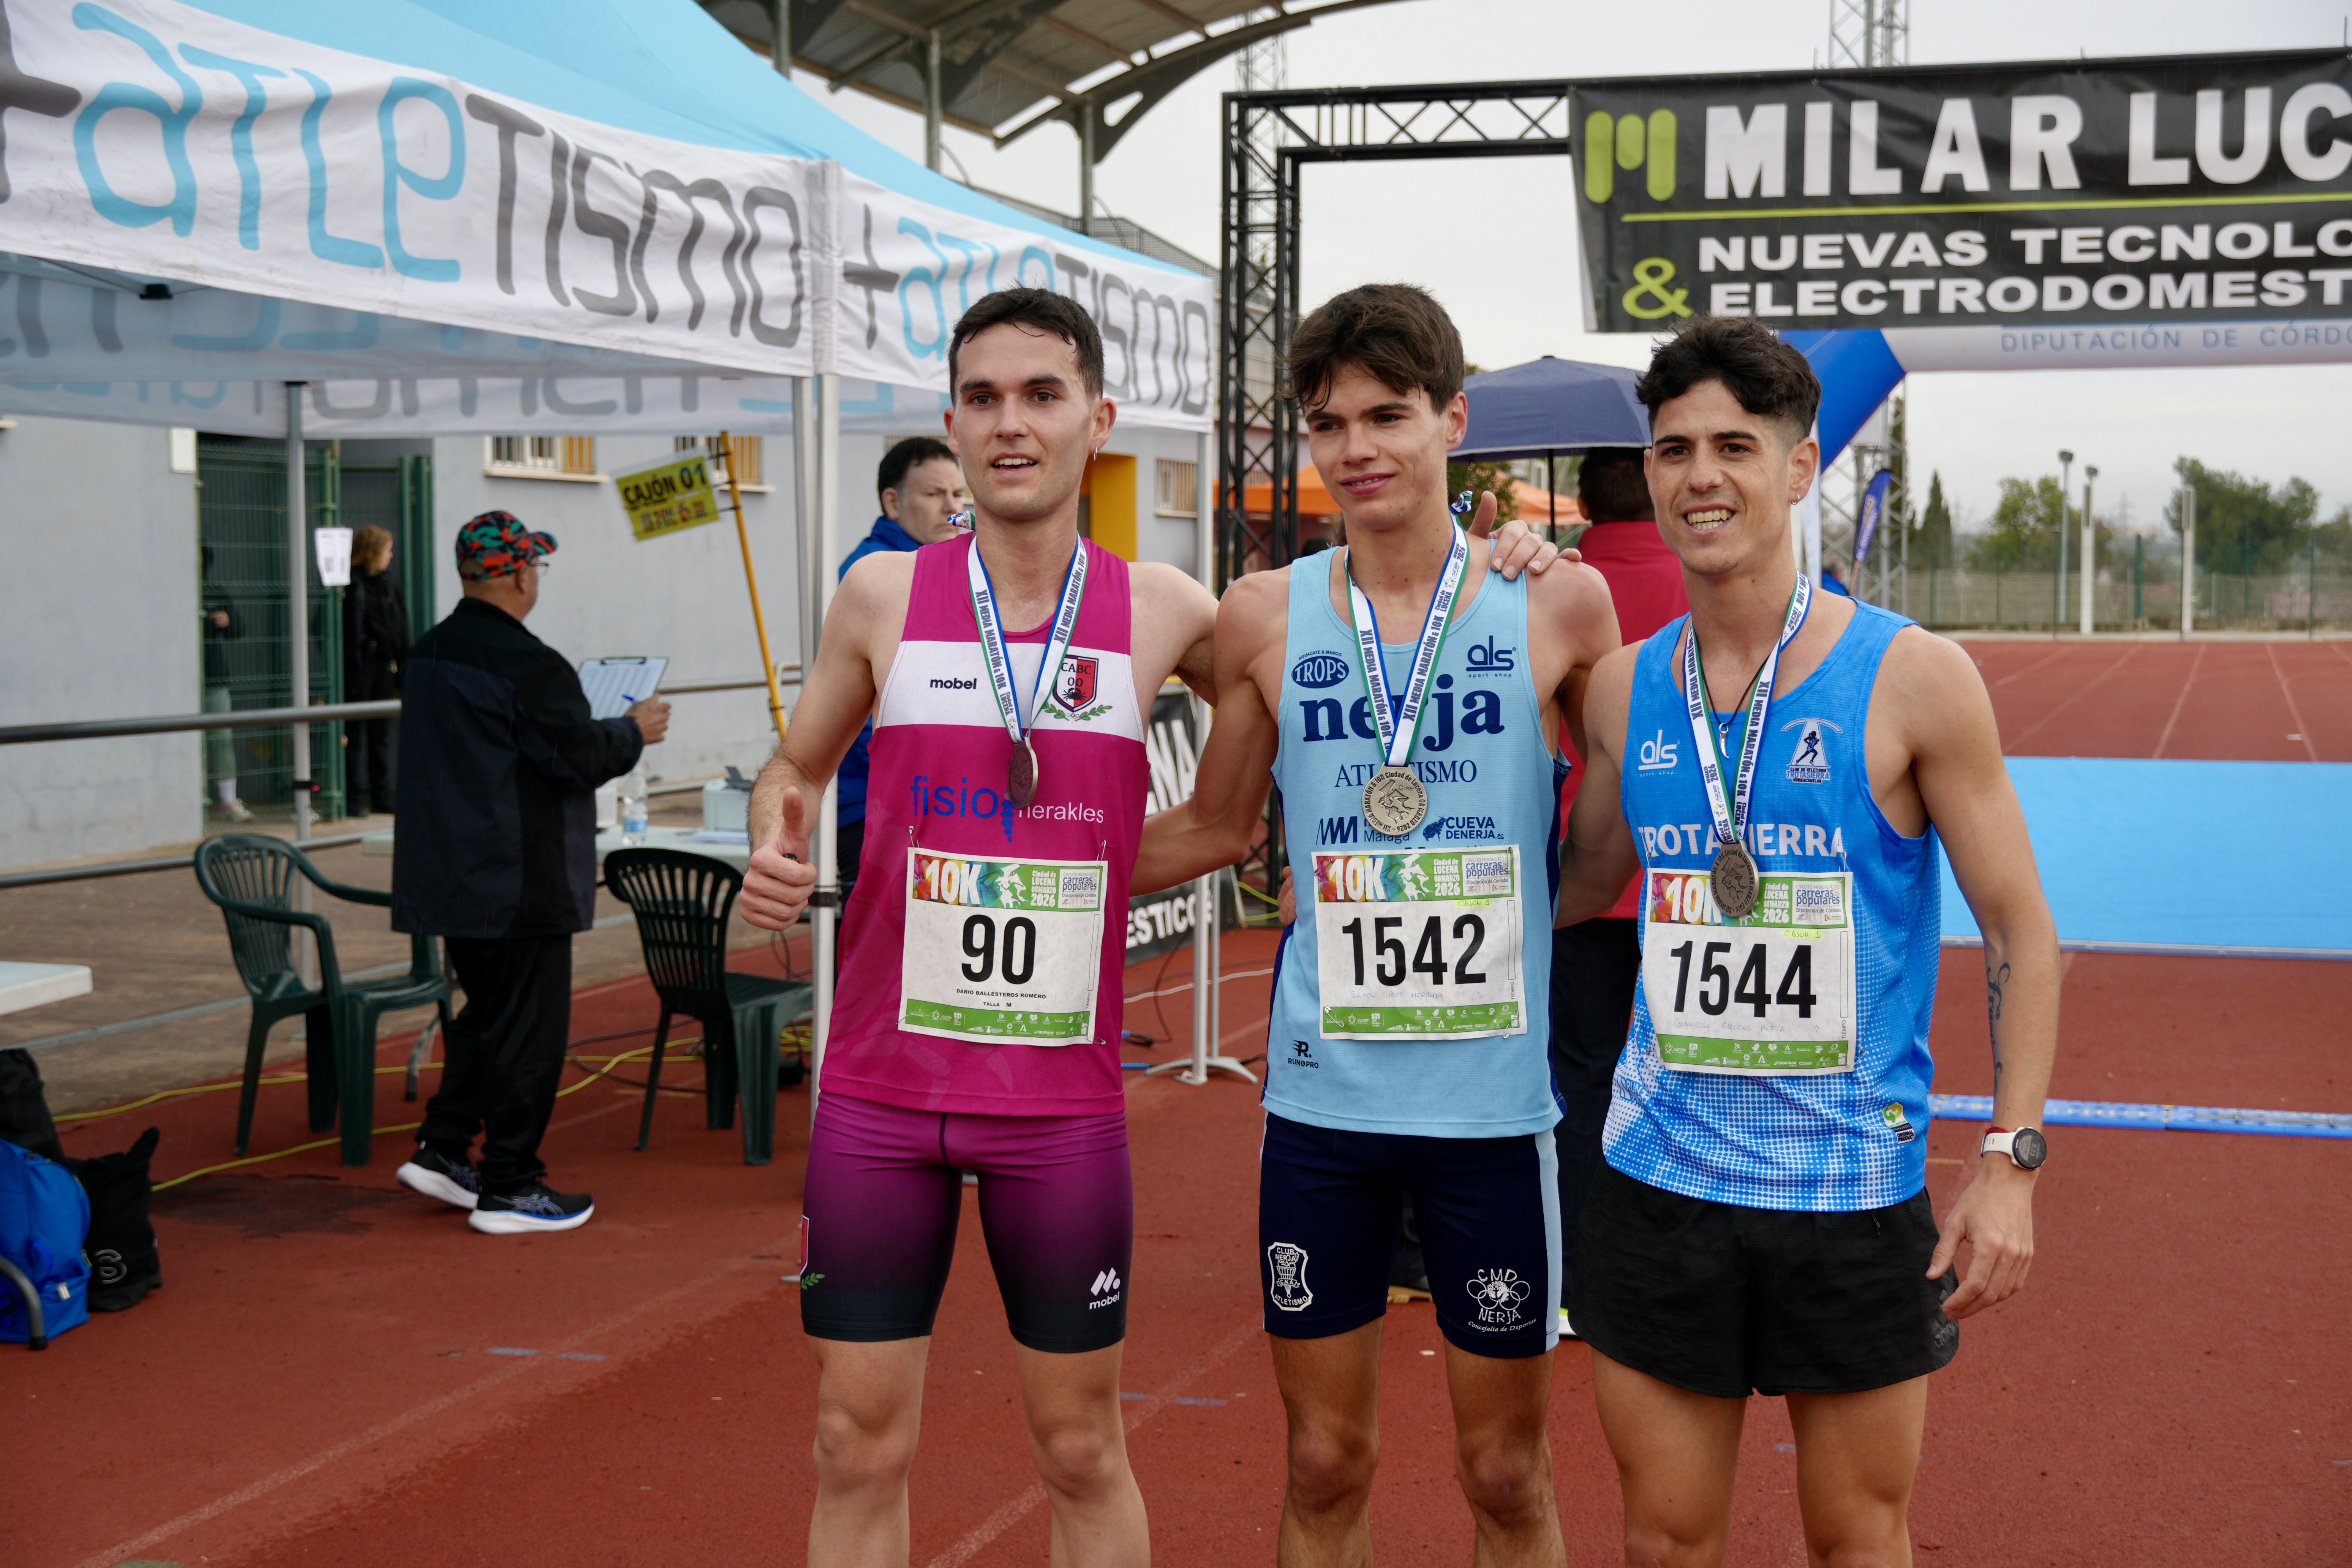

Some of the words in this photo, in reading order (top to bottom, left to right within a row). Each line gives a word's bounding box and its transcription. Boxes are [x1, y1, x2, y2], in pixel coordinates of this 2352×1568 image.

[1704, 94, 2084, 201] MILAR
[1699, 229, 1987, 272] NUEVAS
[1622, 257, 1694, 320] &
[2001, 323, 2181, 353] DIPUTACIÓN
[2203, 326, 2238, 349] DE
[624, 474, 676, 504] CAJÓN
[680, 463, 706, 489] 01
[1457, 546, 1465, 562] 2026
[1067, 569, 1083, 605] MARATÓN
[975, 589, 989, 605] XII
[1440, 592, 1453, 612] LUCENA
[979, 604, 992, 629] MEDIA
[1061, 605, 1075, 628] MEDIA
[1431, 615, 1444, 631] 10K
[1787, 606, 1799, 629] LUCENA
[1054, 626, 1068, 645] XII
[1359, 629, 1373, 645] XII
[985, 629, 1002, 669] MARATÓN
[1299, 650, 1321, 661] AGUACATE
[1417, 635, 1438, 677] MARATÓN
[1466, 635, 1514, 671] als
[1687, 637, 1697, 676] MARATÓN
[1061, 662, 1091, 675] CABC
[1363, 646, 1377, 673] MEDIA
[1295, 658, 1346, 682] TROPS
[930, 678, 977, 689] mobel
[995, 672, 1007, 690] 10K
[1690, 674, 1700, 702] MEDIA
[1756, 681, 1770, 697] XII
[1369, 674, 1388, 719] MARATÓN
[1410, 678, 1425, 704] MEDIA
[1000, 693, 1011, 716] LUCENA
[1299, 674, 1505, 752] neja
[1402, 704, 1418, 722] XII
[1690, 701, 1704, 721] XII
[1749, 700, 1763, 727] MEDIA
[1379, 720, 1393, 738] 10K
[1638, 729, 1677, 770] als
[1740, 729, 1758, 773] MARATÓN
[1708, 763, 1718, 782] 2026
[1786, 771, 1829, 779] TROTASIERRA
[911, 775, 998, 819] fisio
[1411, 779, 1423, 798] Lucena
[1737, 779, 1748, 797] 10K
[1446, 816, 1495, 829] CUEVA
[1721, 818, 1734, 842] LUCENA
[1724, 848, 1738, 857] Ciudad
[1434, 865, 1459, 874] LUCENA
[1466, 861, 1502, 870] carreras
[1466, 866, 1508, 879] populares
[925, 859, 982, 905] 10K
[1032, 877, 1056, 886] LUCENA
[1062, 882, 1097, 892] populares
[1329, 857, 1388, 901] 10K
[1435, 882, 1461, 896] 2026
[1764, 890, 1788, 900] LUCENA
[1796, 889, 1834, 898] carreras
[1031, 893, 1056, 907] 2026
[1796, 895, 1840, 907] populares
[1762, 908, 1789, 923] 2026
[962, 914, 1036, 985] 90
[1342, 914, 1486, 986] 1542
[1670, 940, 1816, 1018] 1544
[1677, 1019, 1693, 1028] JUAN
[1275, 1253, 1296, 1262] NERJA
[1477, 1268, 1517, 1282] CMD
[1089, 1291, 1120, 1310] mobel
[1274, 1294, 1308, 1306] ATLETISMO
[1478, 1307, 1521, 1324] NERJA
[1509, 1318, 1536, 1331] Deportes
